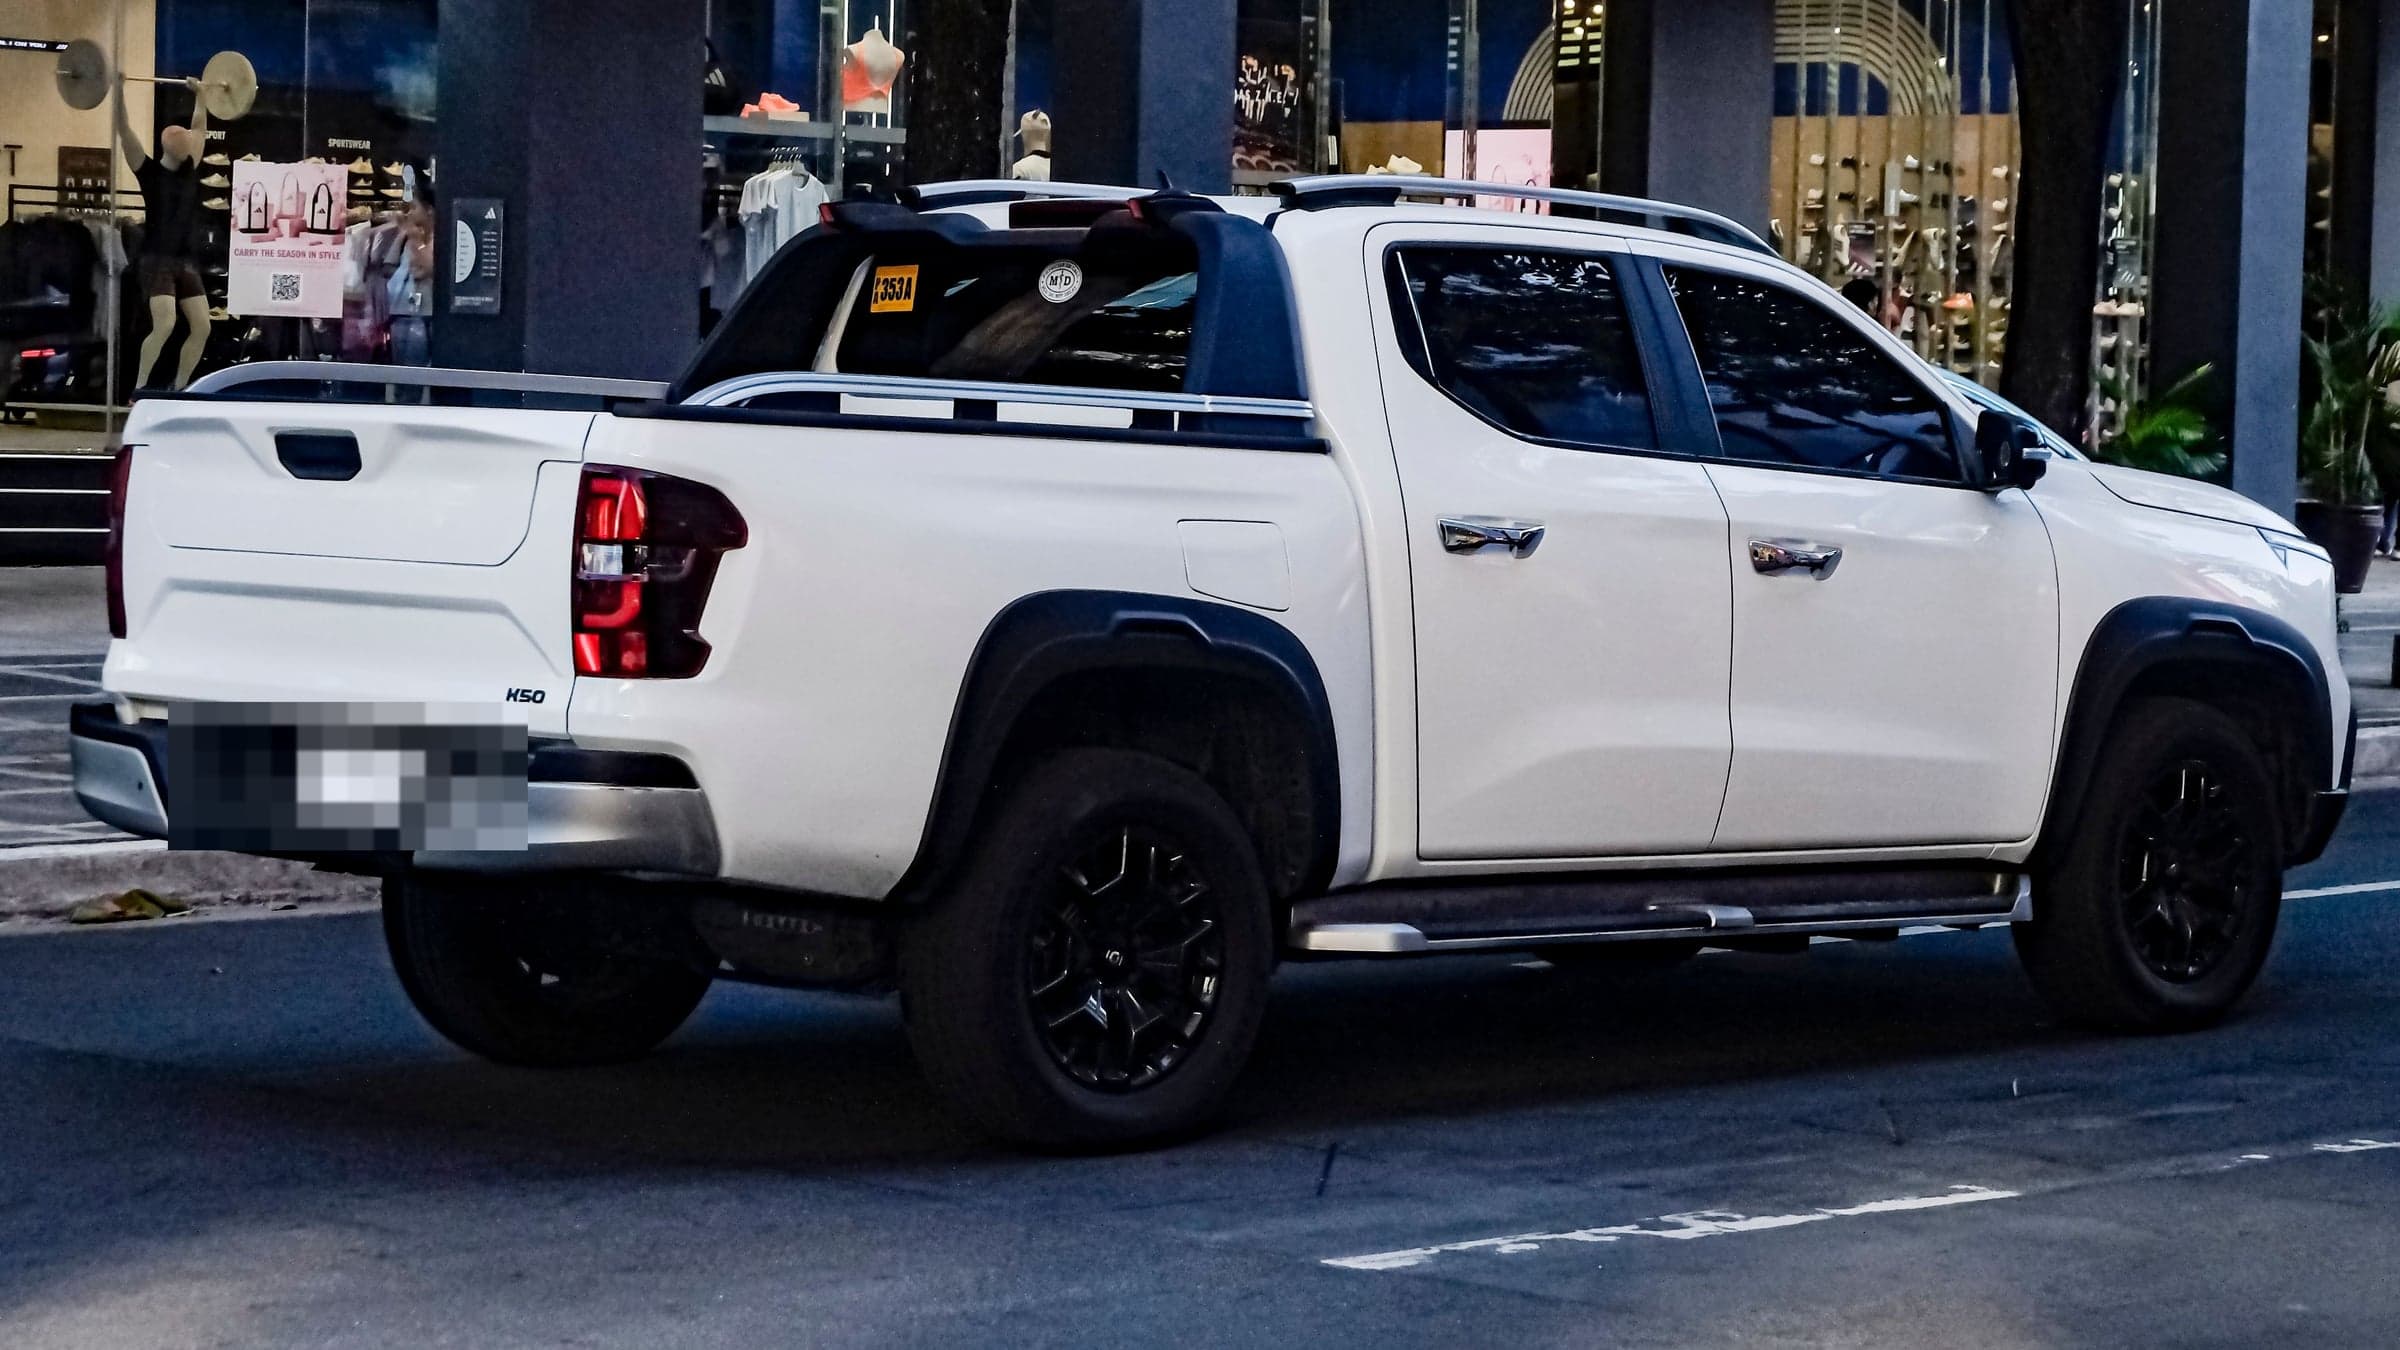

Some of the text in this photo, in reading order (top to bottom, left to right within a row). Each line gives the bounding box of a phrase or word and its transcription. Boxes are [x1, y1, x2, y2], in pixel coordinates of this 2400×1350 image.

[328, 138, 371, 150] SPORTSWEAR
[234, 248, 341, 260] CARRY THE SEASON IN STYLE
[880, 276, 913, 302] 353A
[506, 687, 546, 704] K50
